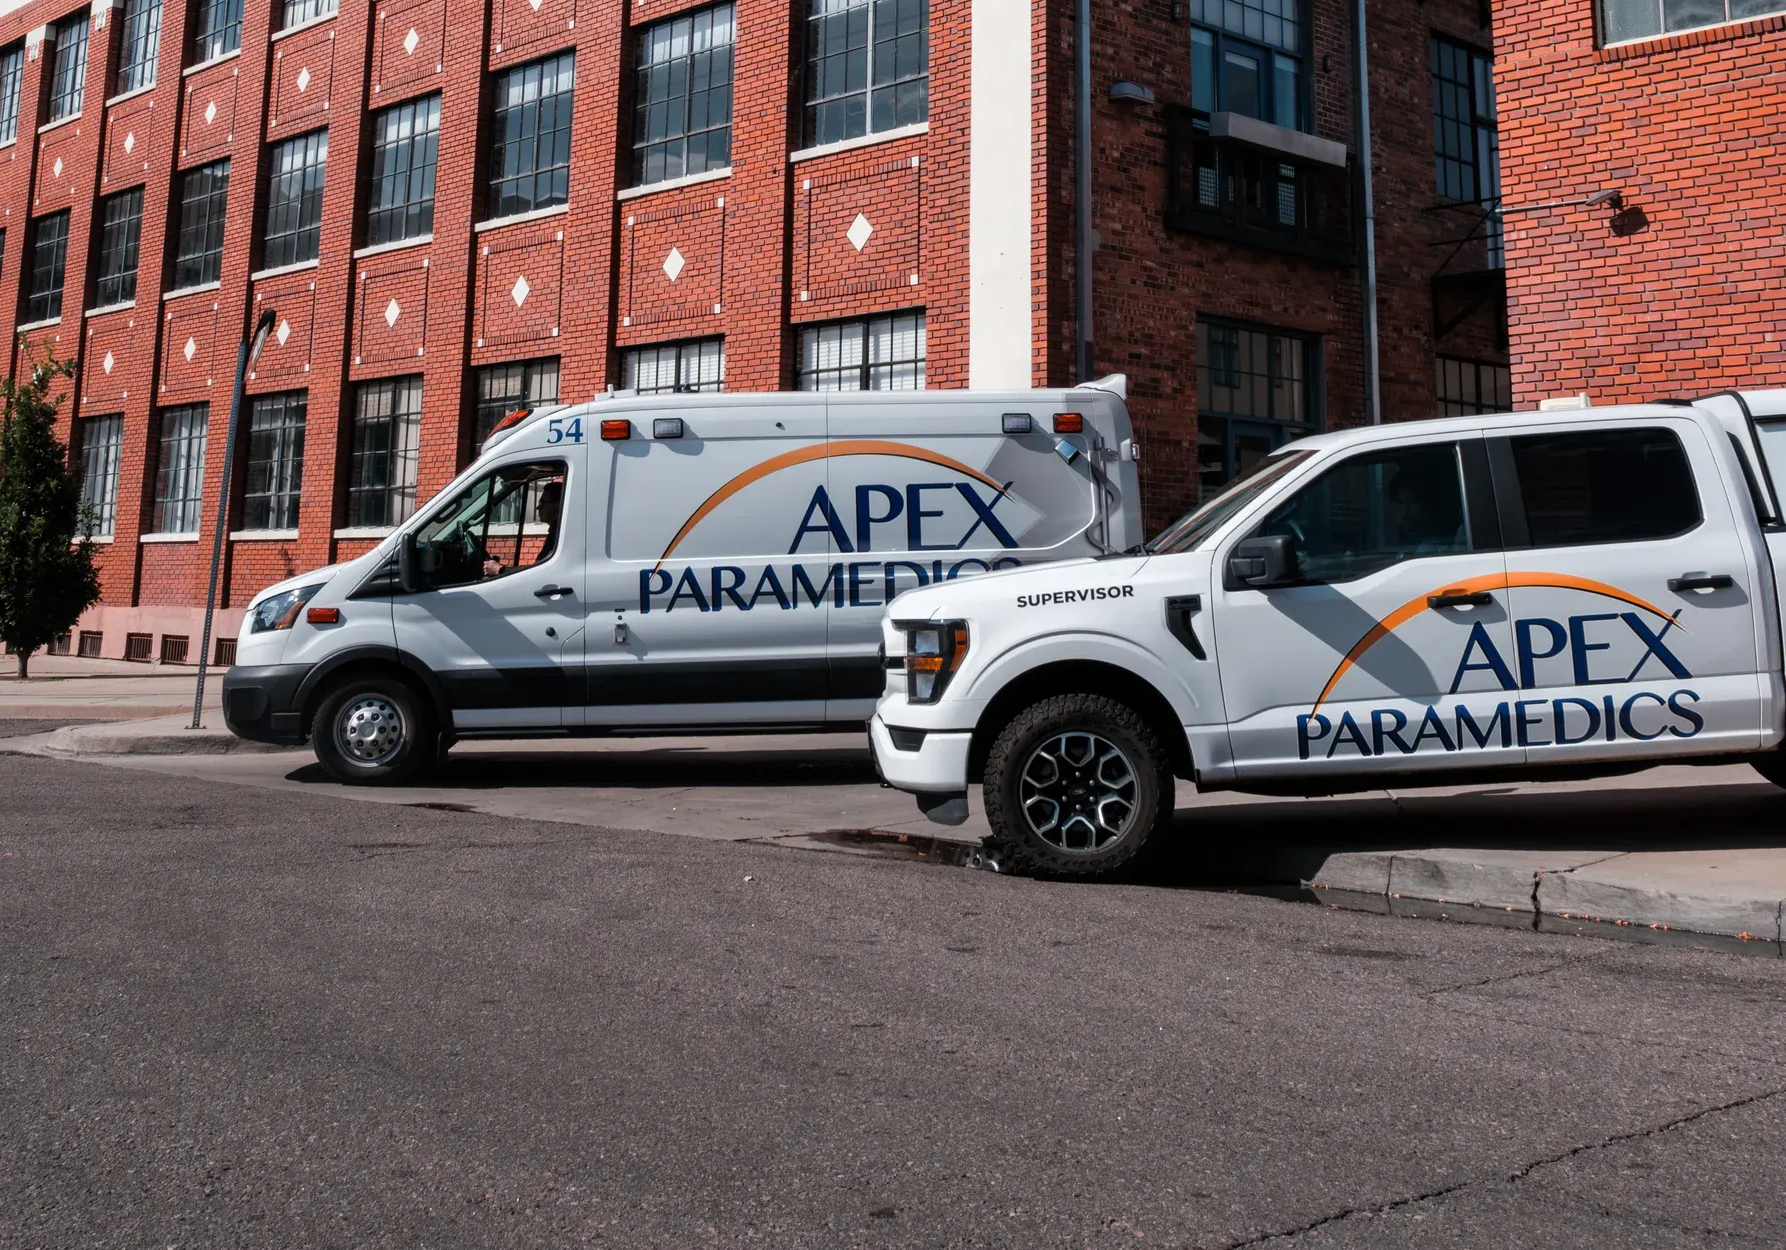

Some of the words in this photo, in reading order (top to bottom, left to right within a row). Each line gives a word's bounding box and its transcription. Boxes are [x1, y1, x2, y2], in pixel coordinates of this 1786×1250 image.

[547, 418, 583, 444] 54
[787, 481, 1021, 554] APEX
[1017, 585, 1134, 608] SUPERVISOR
[1448, 608, 1693, 694] APEX
[1296, 689, 1704, 760] PARAMEDICS
